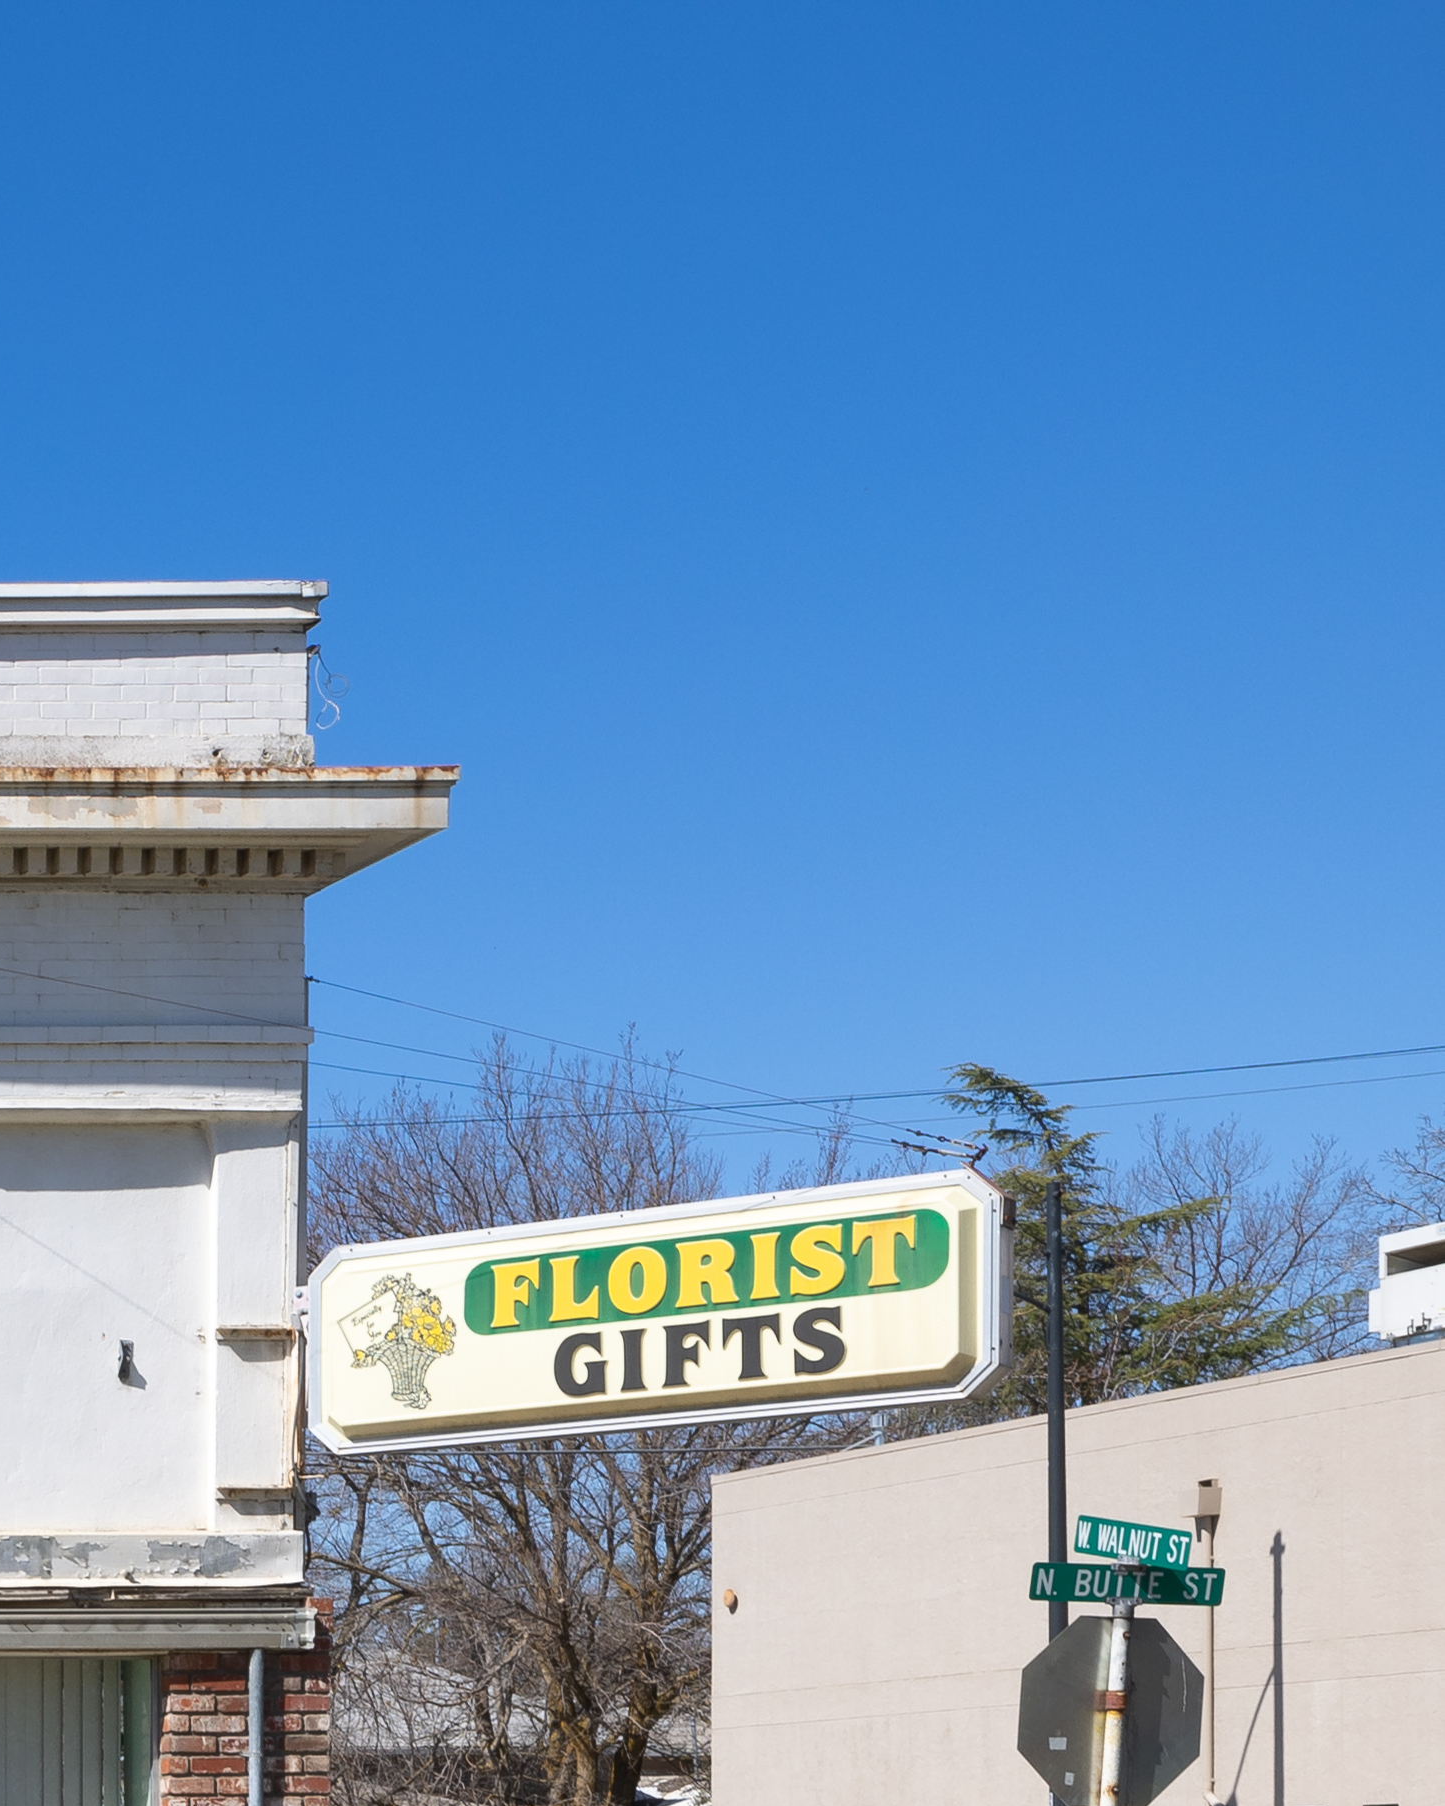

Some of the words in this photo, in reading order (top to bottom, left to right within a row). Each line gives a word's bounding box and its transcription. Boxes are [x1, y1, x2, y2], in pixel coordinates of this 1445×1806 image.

[489, 1214, 918, 1330] FLORIST
[553, 1306, 847, 1398] GIFTS
[1077, 1519, 1092, 1550] W.
[1098, 1523, 1163, 1560] WALNUT
[1166, 1534, 1190, 1565] ST
[1035, 1568, 1057, 1596] N.
[1074, 1570, 1164, 1599] BUTTE
[1183, 1572, 1217, 1601] ST
